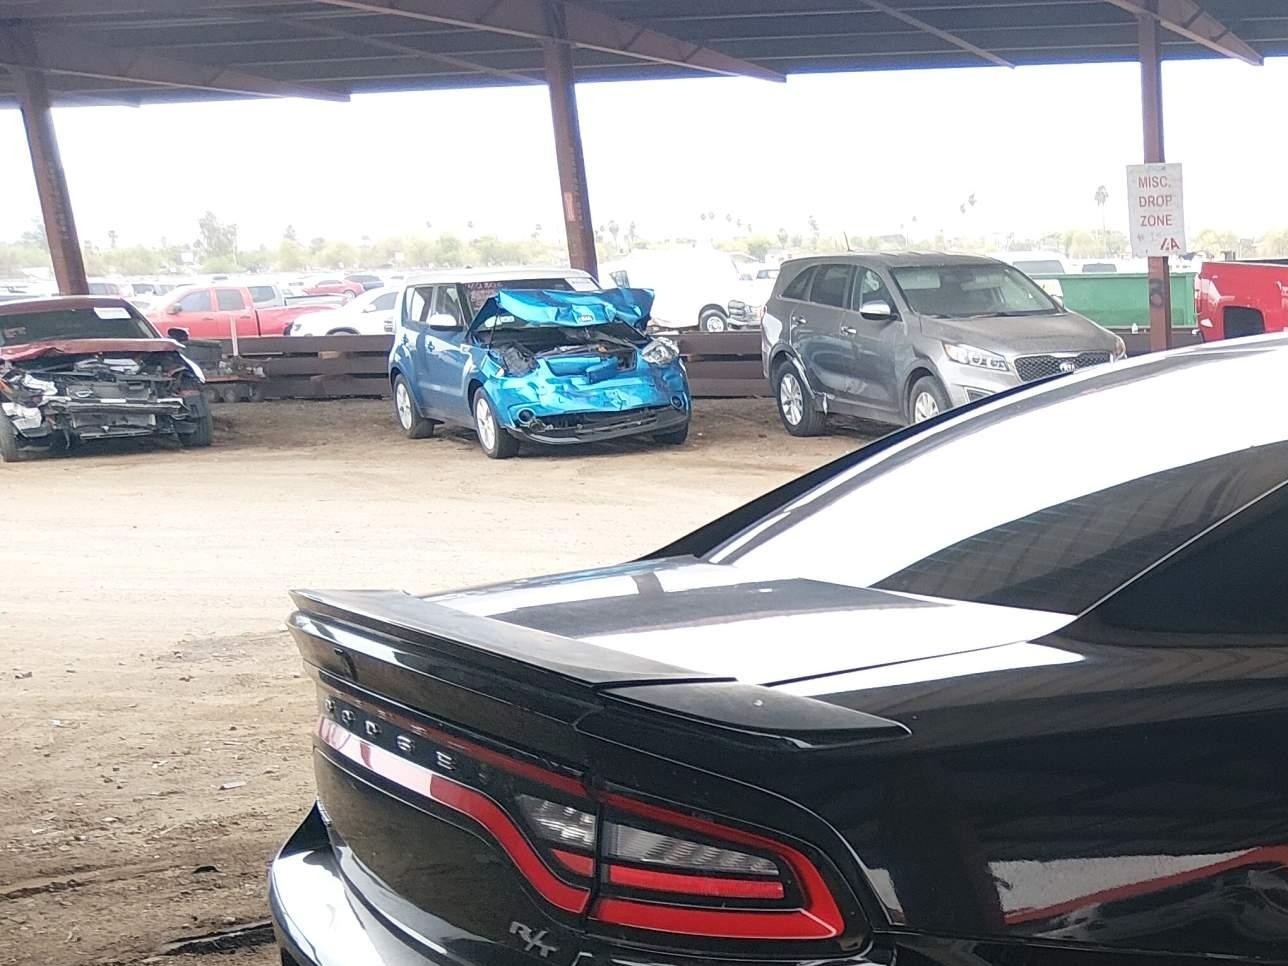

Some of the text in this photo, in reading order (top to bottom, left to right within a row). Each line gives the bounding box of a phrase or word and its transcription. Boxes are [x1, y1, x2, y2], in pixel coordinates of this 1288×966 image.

[1138, 175, 1171, 189] MISC.
[1138, 194, 1172, 208] DROP
[1140, 214, 1173, 227] ZONE
